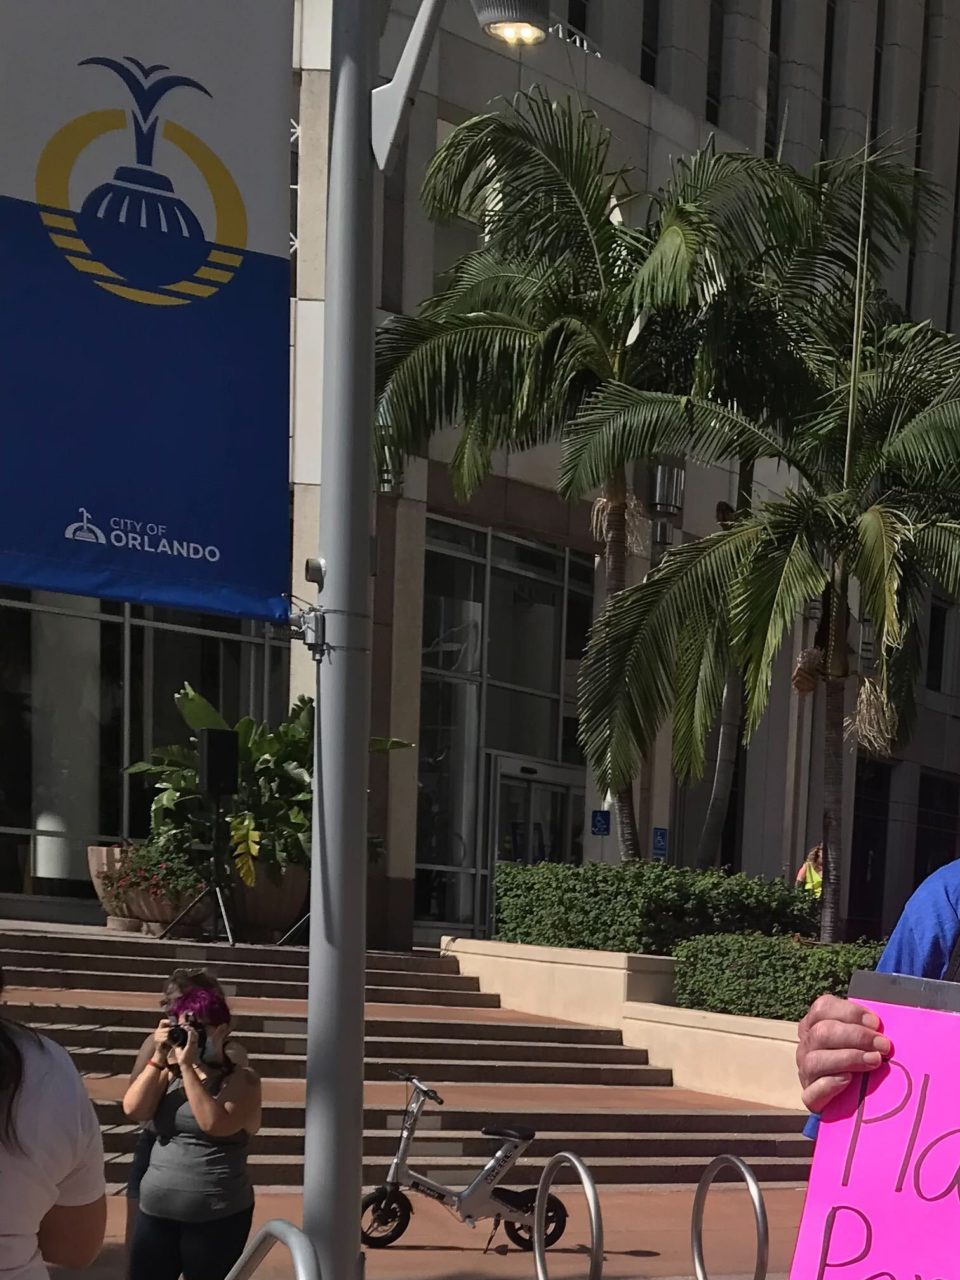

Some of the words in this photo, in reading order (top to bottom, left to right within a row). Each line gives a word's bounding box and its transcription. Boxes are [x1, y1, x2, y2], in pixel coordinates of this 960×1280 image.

[110, 517, 143, 531] CITY
[146, 523, 167, 535] OF
[110, 530, 220, 562] ORLANDO
